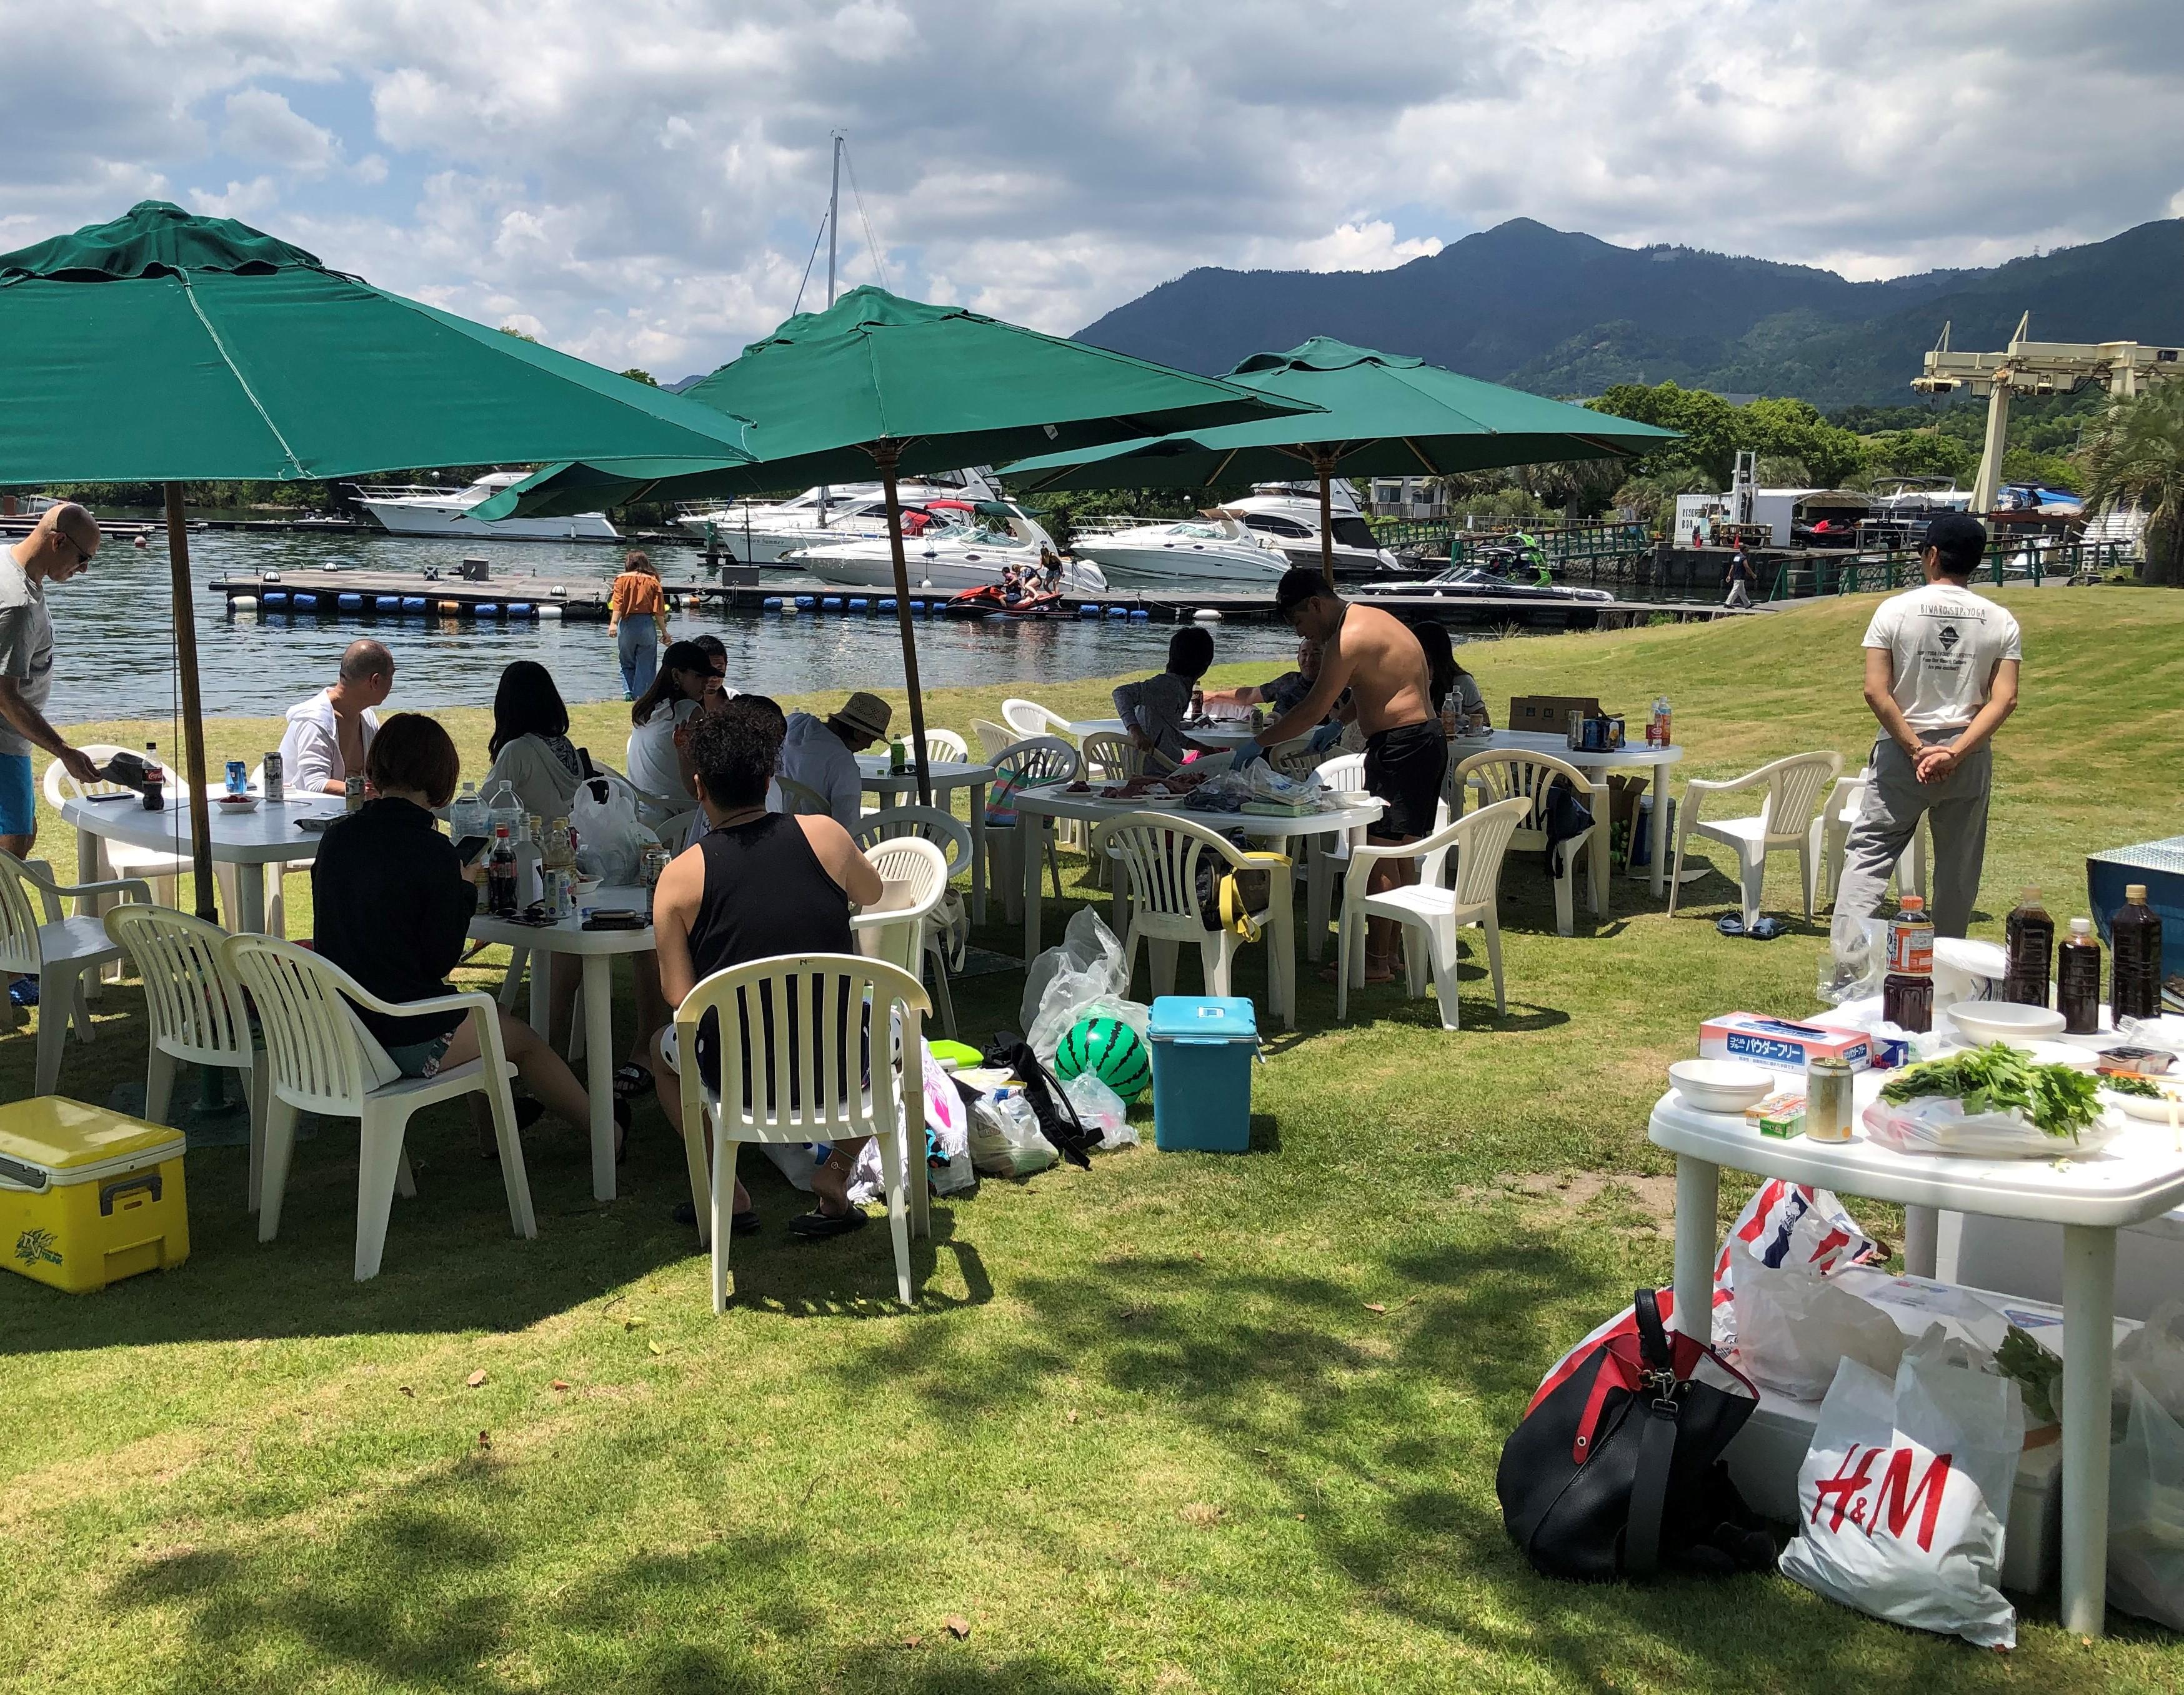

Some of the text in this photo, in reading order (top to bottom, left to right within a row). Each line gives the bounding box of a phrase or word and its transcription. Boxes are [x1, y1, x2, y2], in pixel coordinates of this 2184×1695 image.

[1745, 1038, 1800, 1059] パウダーフリー
[1811, 1443, 1952, 1553] H&M
